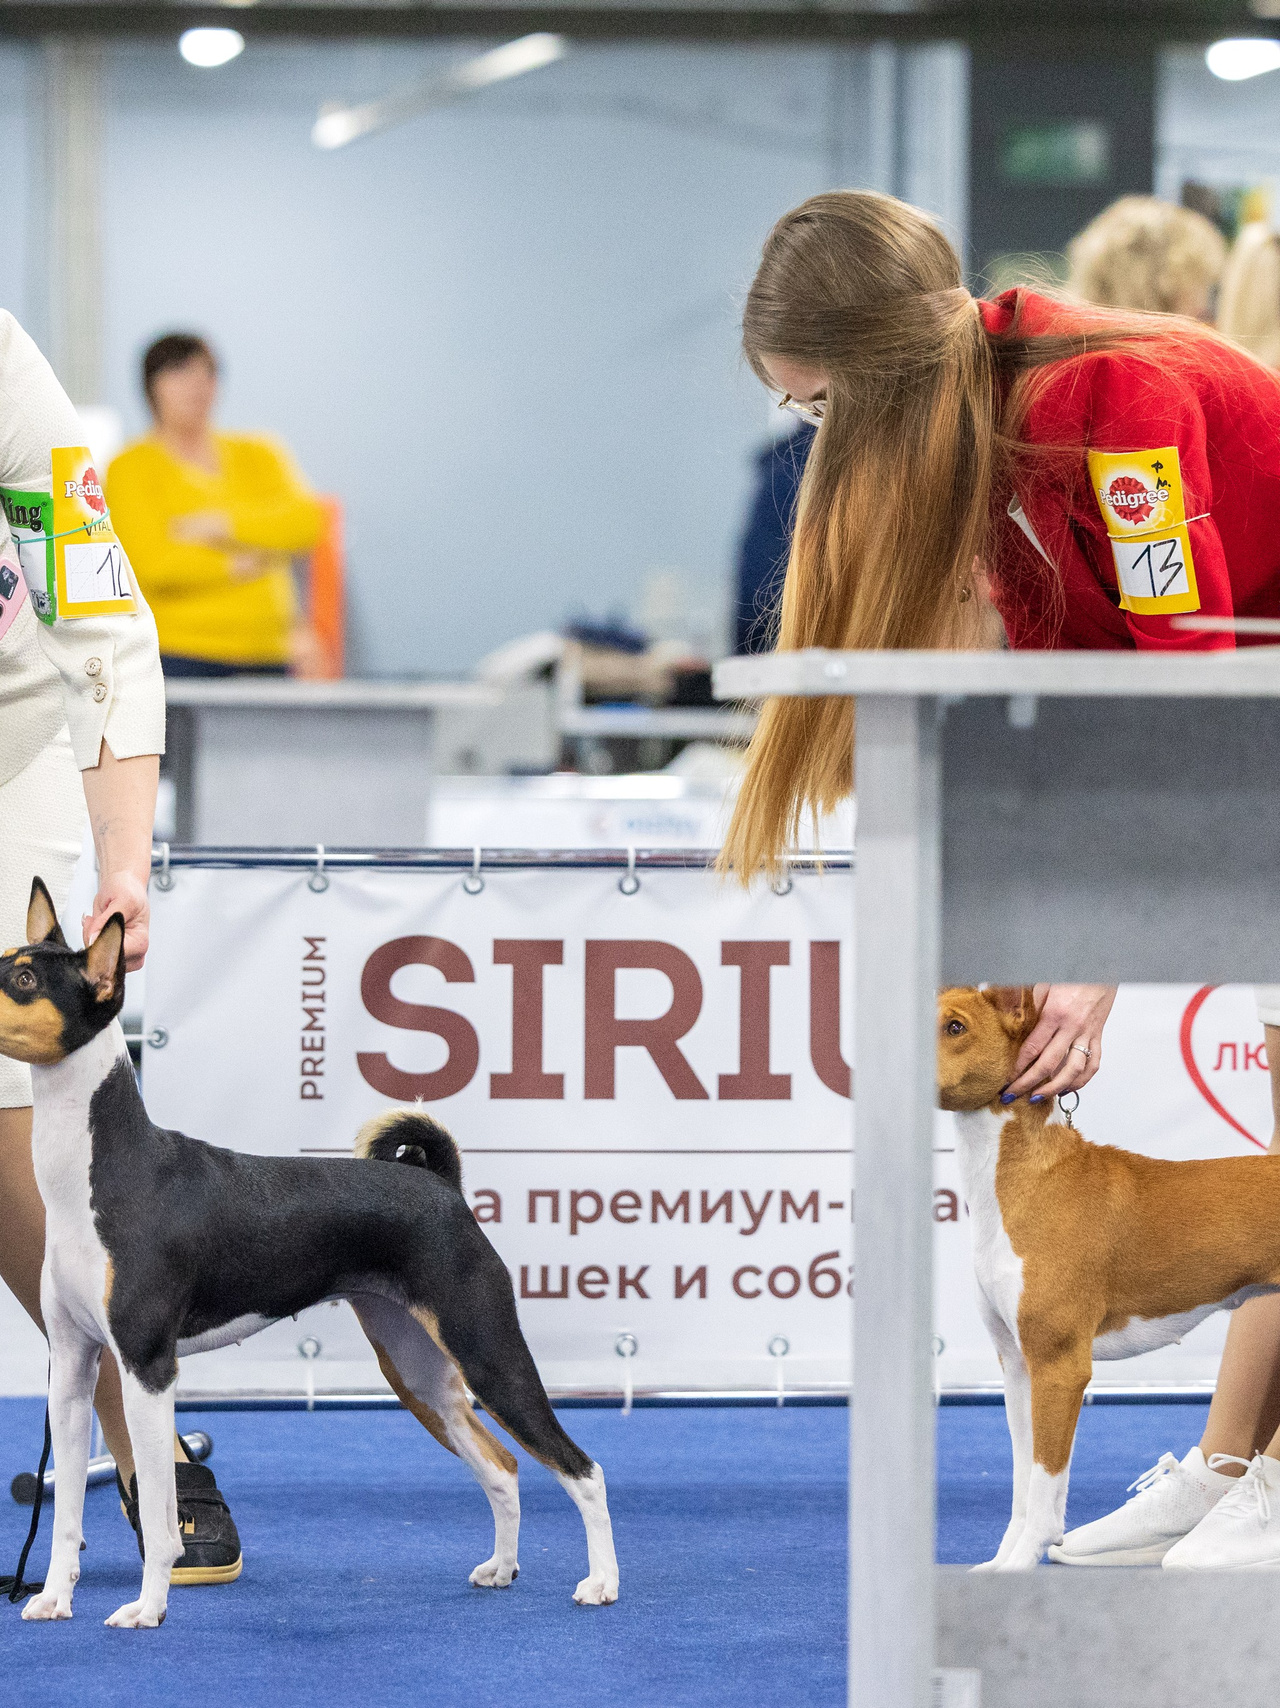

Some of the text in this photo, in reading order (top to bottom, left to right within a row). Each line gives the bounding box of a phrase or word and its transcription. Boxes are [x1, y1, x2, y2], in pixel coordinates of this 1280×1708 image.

[64, 481, 103, 500] Pedig
[1098, 487, 1169, 508] Pedigree
[1132, 539, 1183, 598] 13
[300, 936, 327, 1100] PREMIUM
[674, 1265, 709, 1299] и
